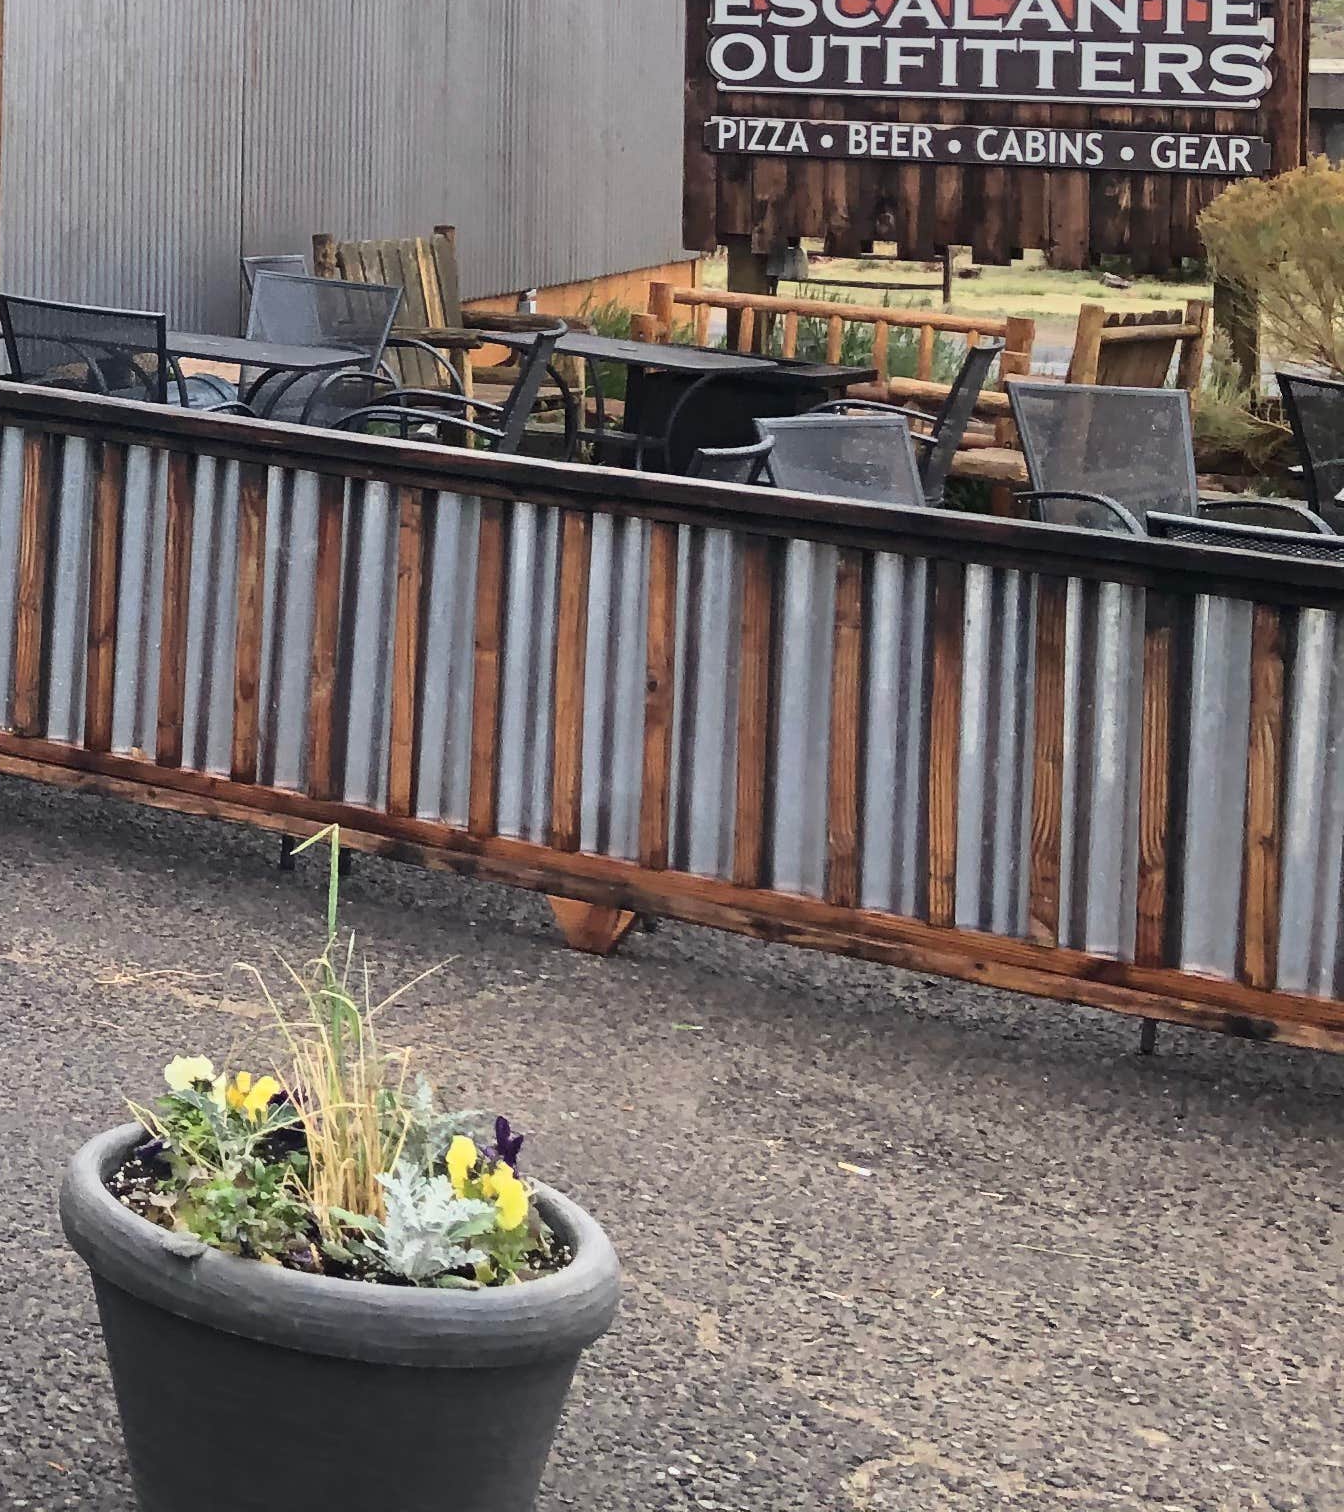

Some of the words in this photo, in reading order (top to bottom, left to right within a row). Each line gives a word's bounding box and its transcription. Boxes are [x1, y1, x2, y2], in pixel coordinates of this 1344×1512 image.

[710, 32, 1267, 97] OUTFITTERS
[718, 119, 810, 153] PIZZA
[848, 124, 935, 159] BEER
[976, 128, 1104, 166] CABINS
[1150, 136, 1253, 172] GEAR
